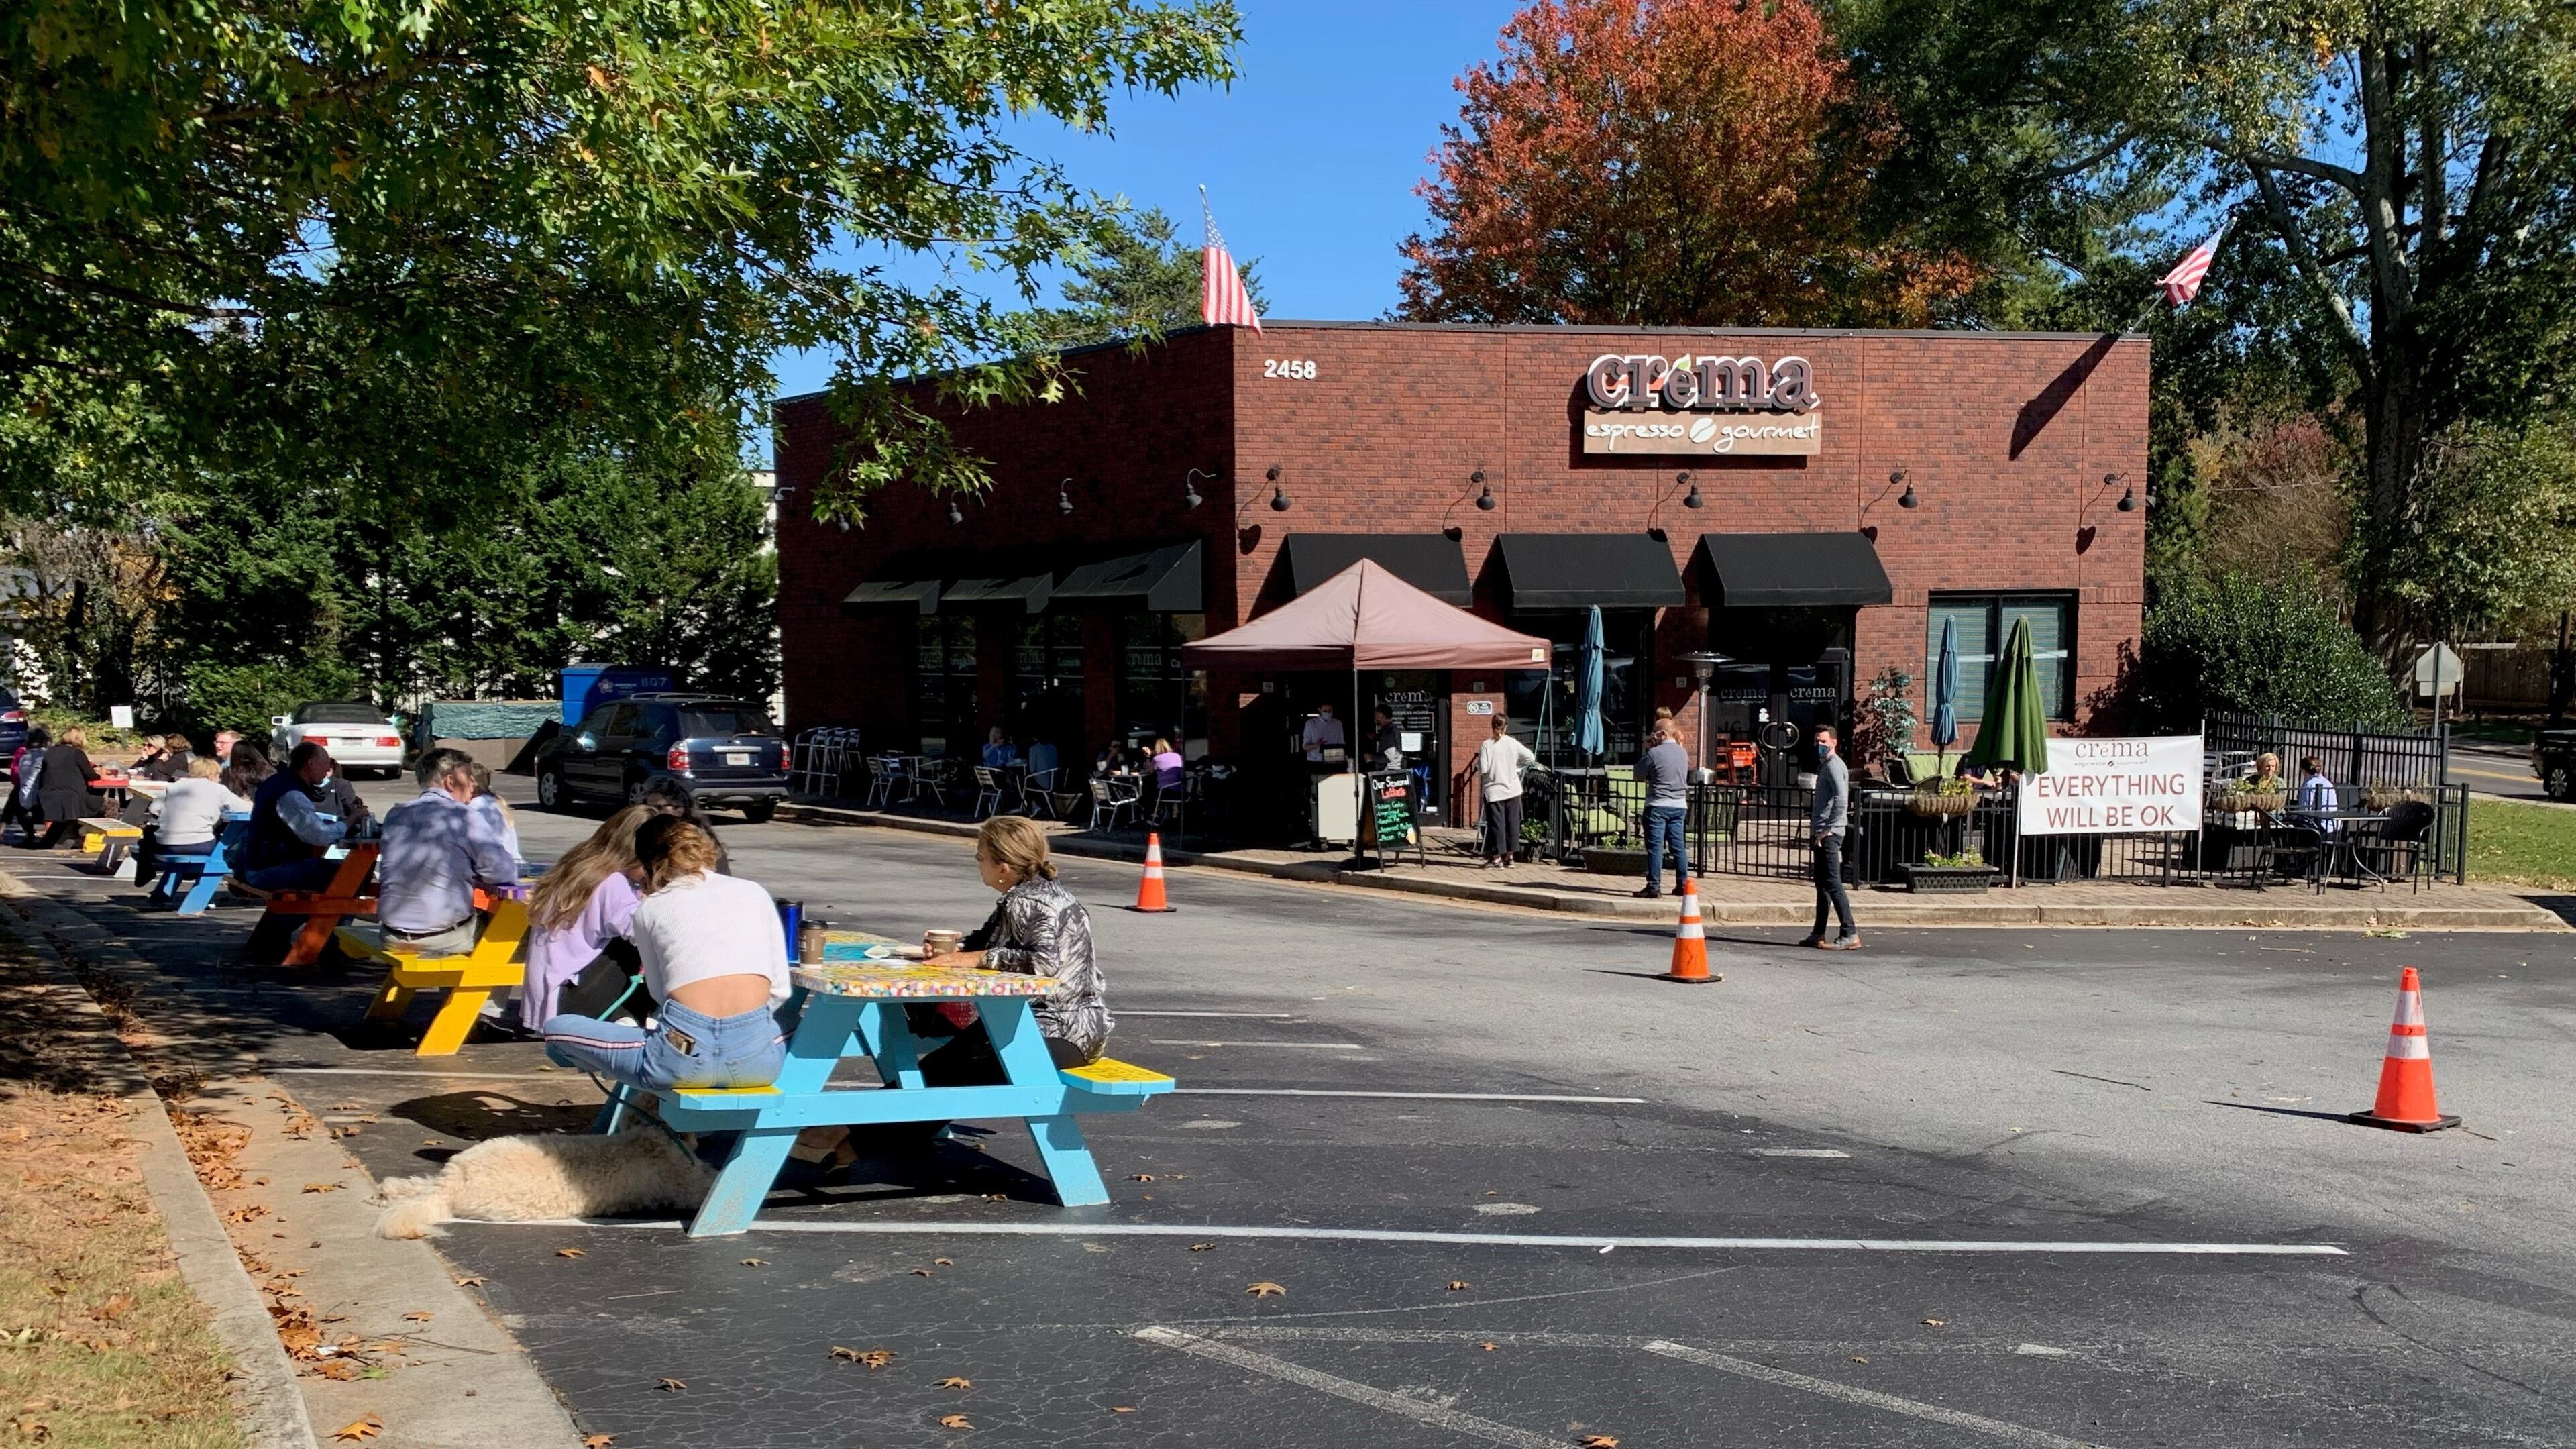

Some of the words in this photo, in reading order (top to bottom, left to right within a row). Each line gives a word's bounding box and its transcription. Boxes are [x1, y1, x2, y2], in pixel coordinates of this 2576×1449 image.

[1264, 359, 1316, 380] 2458
[1586, 423, 1684, 451] espresso
[1713, 415, 1820, 453] gourmet
[1372, 779, 1385, 790] Our
[2038, 773, 2185, 798] EVERYTHING
[2047, 806, 2099, 828] WILL
[2106, 806, 2133, 827] BE
[2141, 804, 2175, 826] OK
